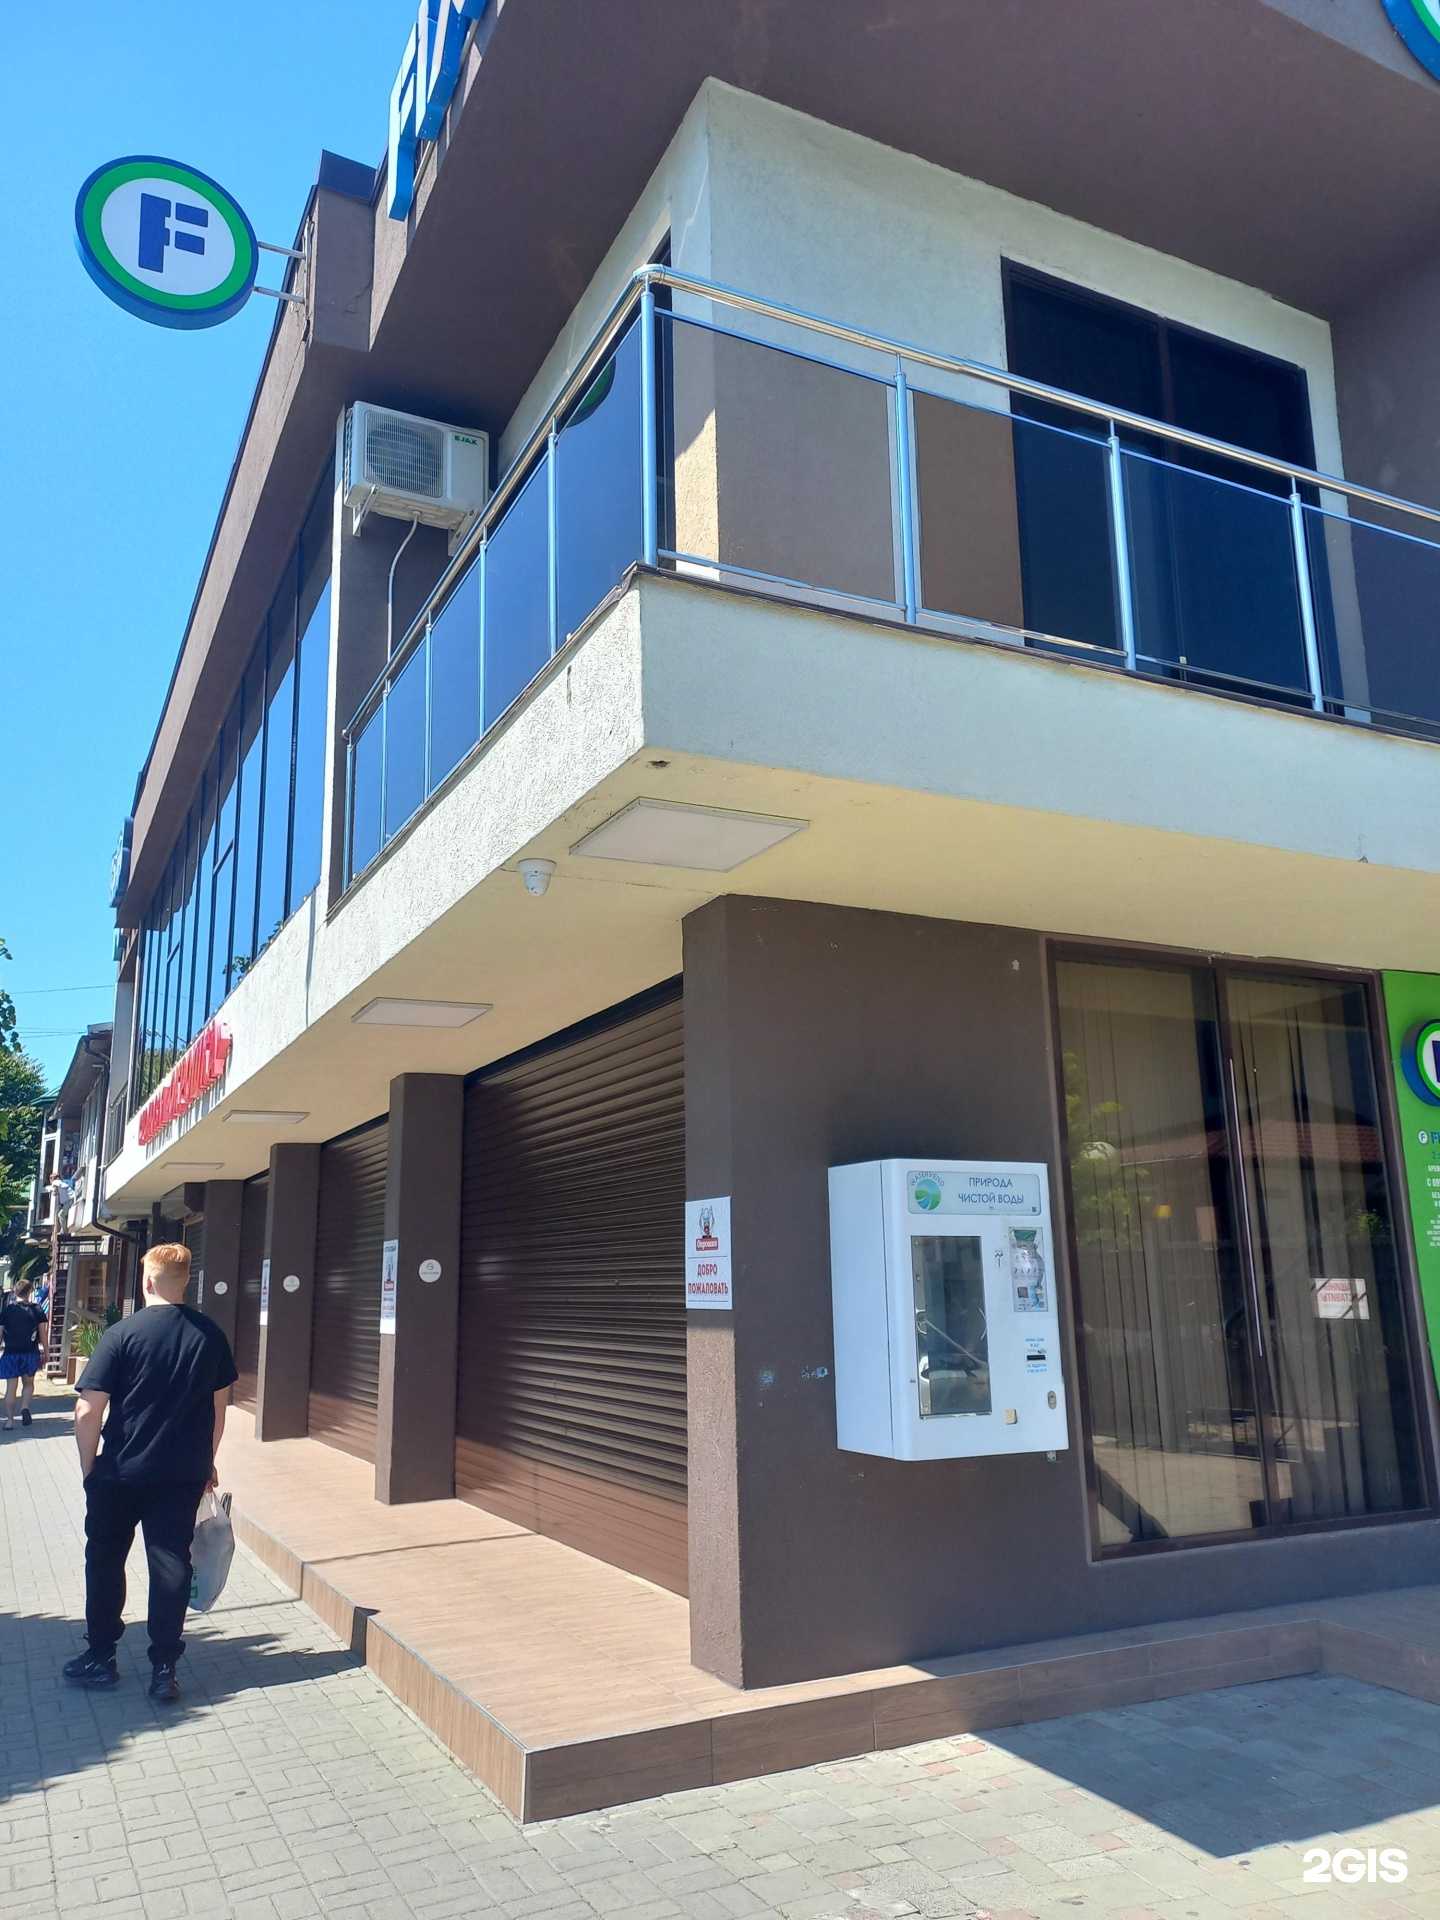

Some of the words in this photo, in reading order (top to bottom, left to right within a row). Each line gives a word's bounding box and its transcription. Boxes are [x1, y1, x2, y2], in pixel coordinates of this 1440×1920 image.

[138, 192, 208, 273] F
[968, 1176, 1014, 1188] ПРИРОДА
[958, 1192, 996, 1205] ЧИСТОЙ
[999, 1193, 1024, 1205] ВОДЫ
[697, 1263, 718, 1278] ДОБРО
[688, 1282, 729, 1296] ПОЖАЛОВАТЬ
